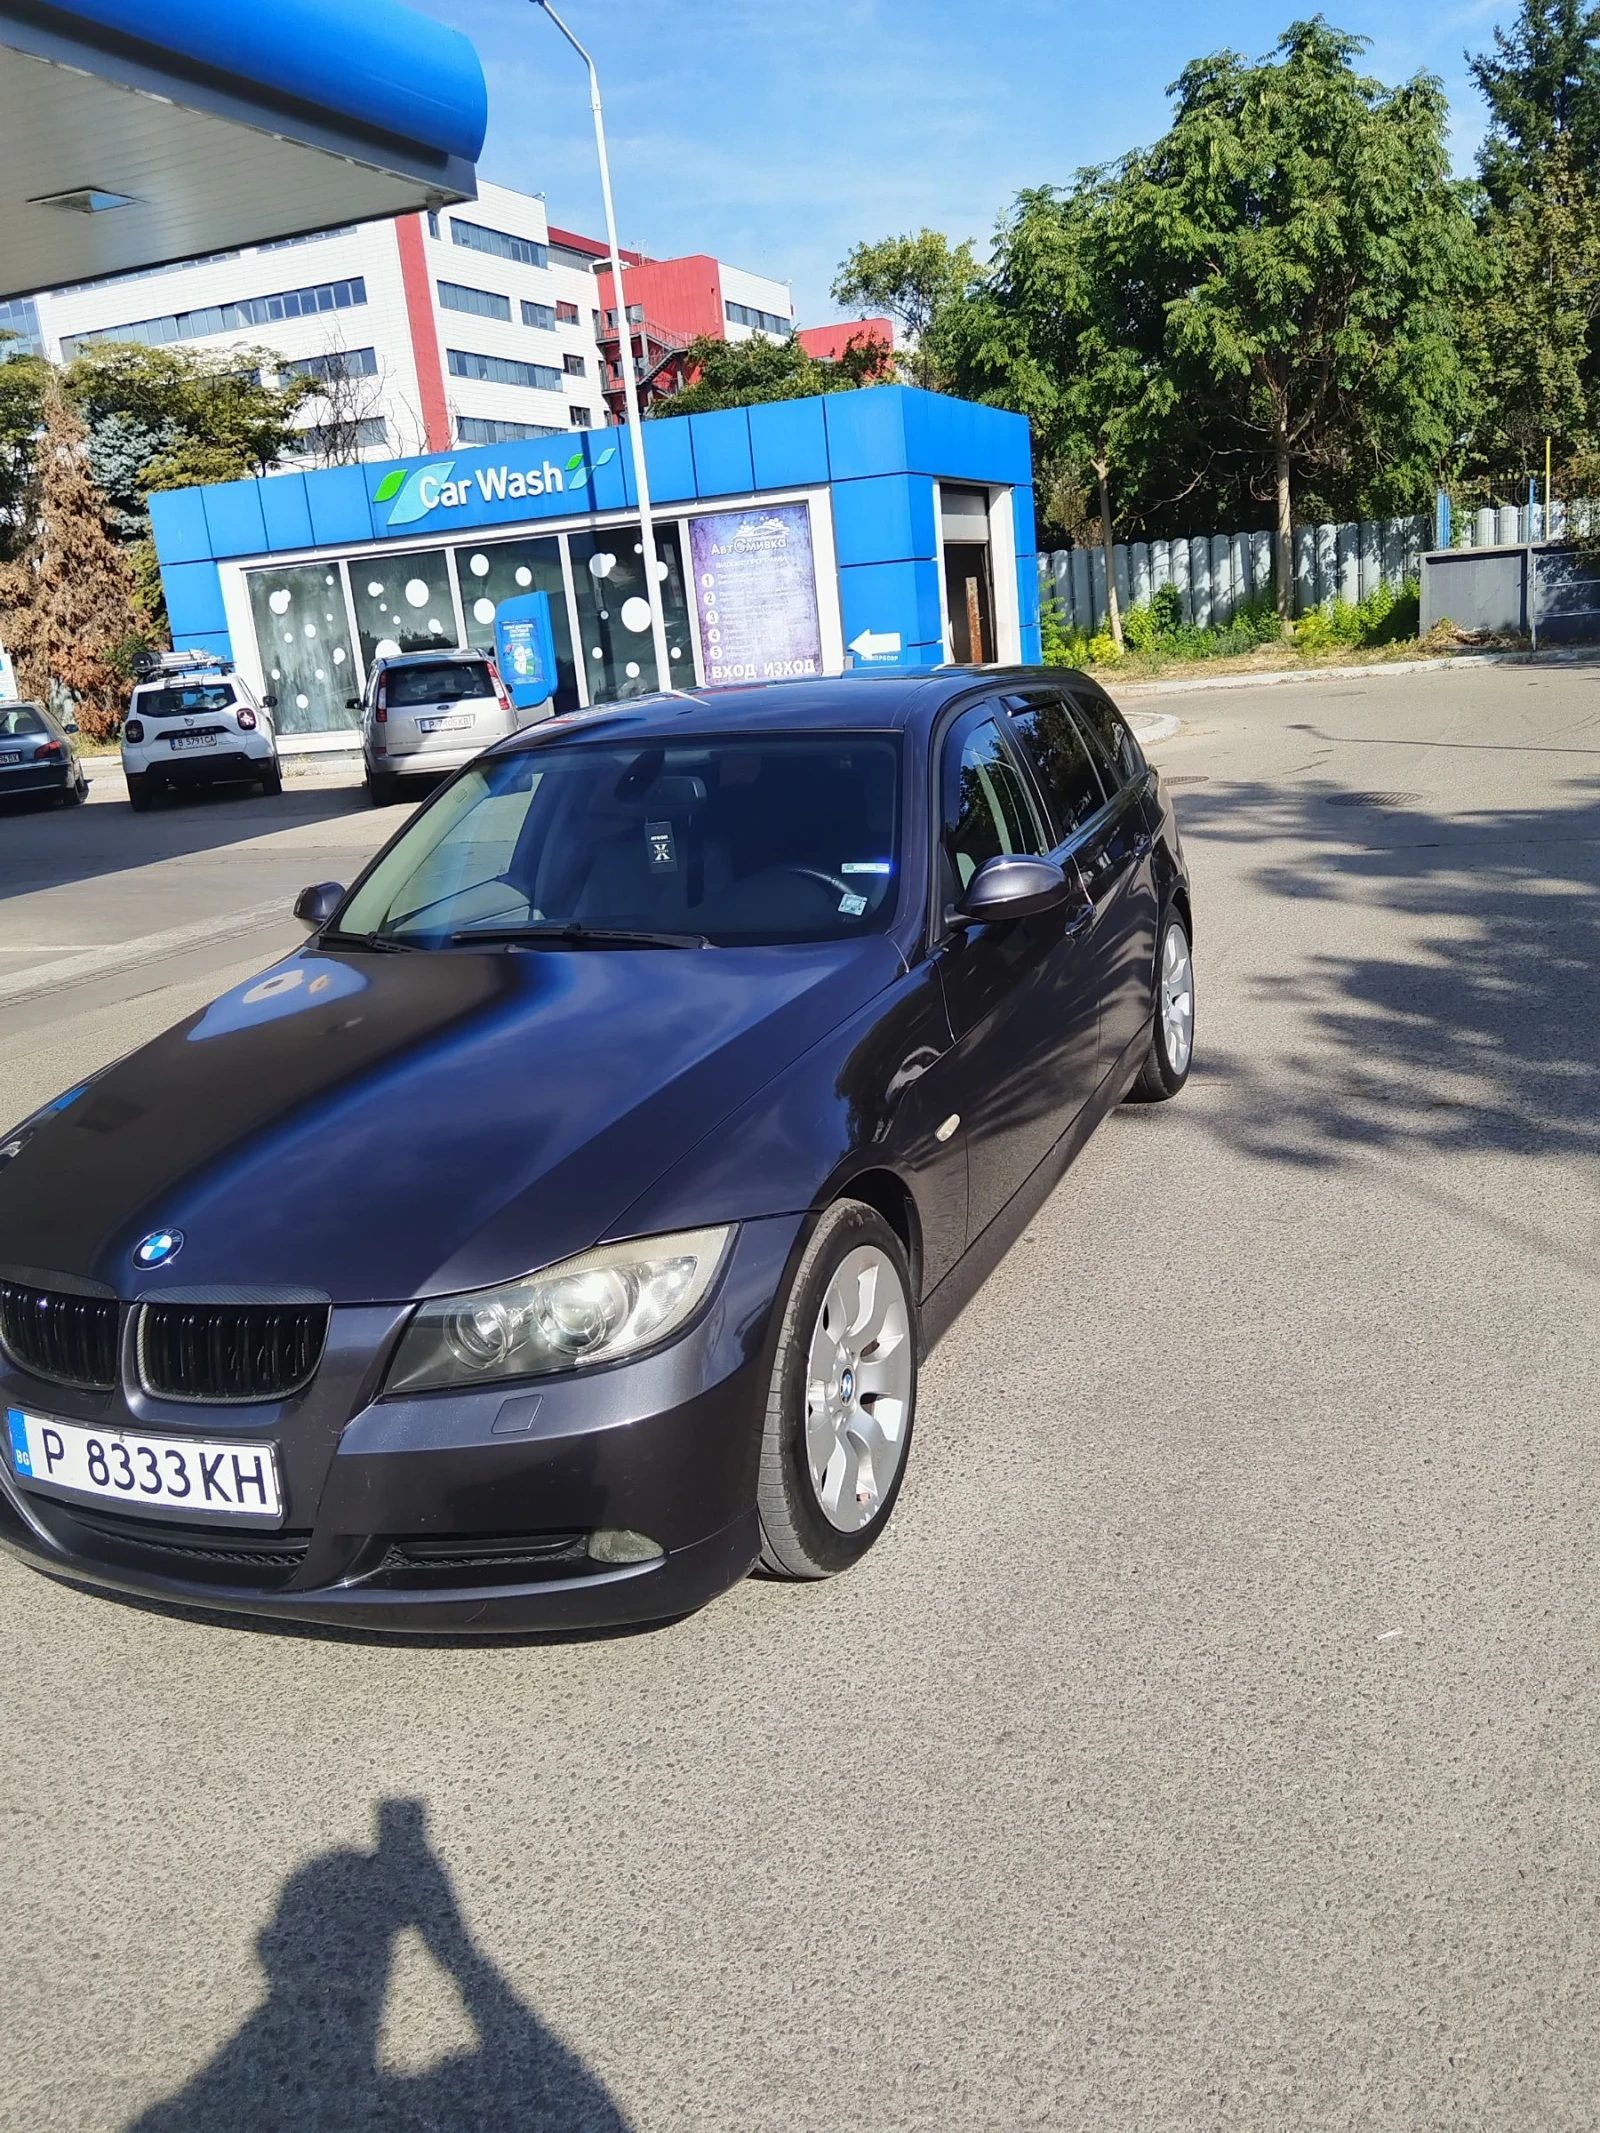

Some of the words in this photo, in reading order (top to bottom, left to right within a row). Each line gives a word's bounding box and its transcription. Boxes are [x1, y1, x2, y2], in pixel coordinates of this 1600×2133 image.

[419, 475, 473, 510] Car
[475, 460, 564, 502] Wash
[711, 663, 757, 679] ВХОД
[764, 658, 816, 677] ИЗХОД
[15, 1449, 30, 1467] BG
[41, 1427, 66, 1475] P
